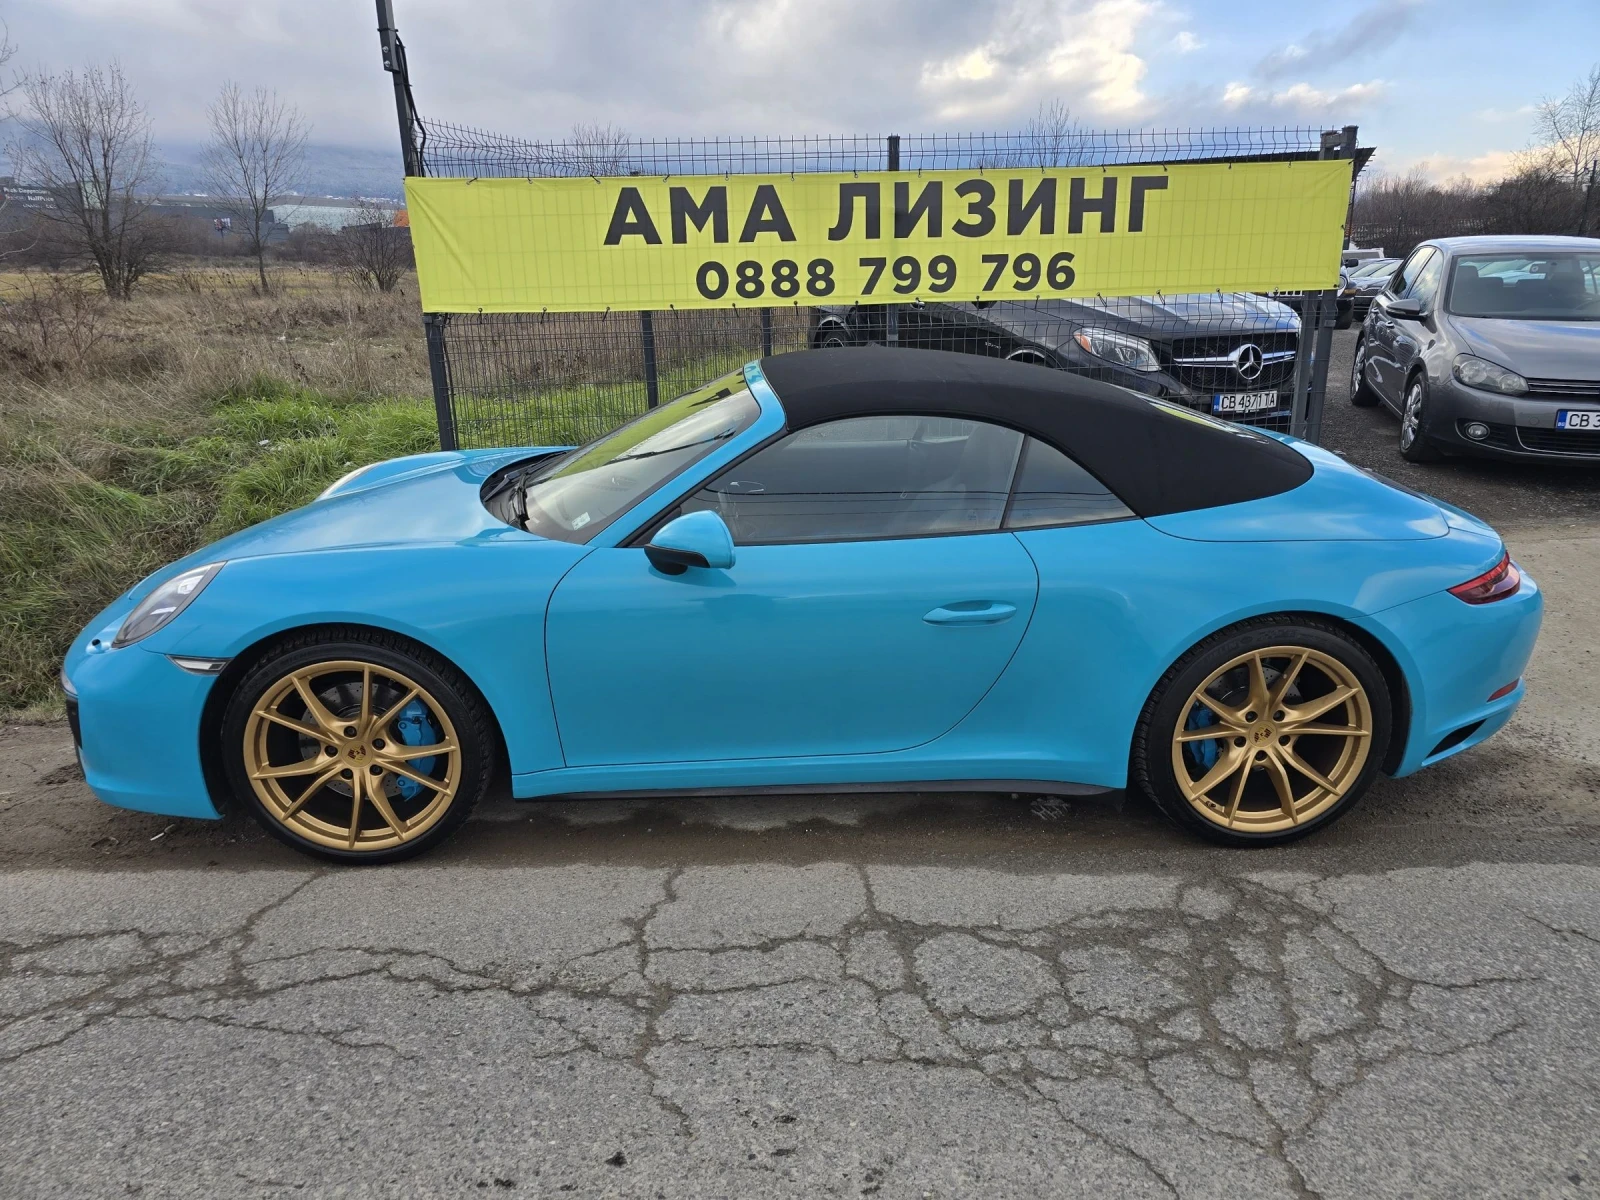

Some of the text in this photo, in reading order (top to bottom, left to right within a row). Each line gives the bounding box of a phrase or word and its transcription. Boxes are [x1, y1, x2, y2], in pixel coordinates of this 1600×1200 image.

[603, 175, 1169, 246] АМА ЛИЗИНГ
[695, 252, 1076, 300] 0888 799 796
[1569, 414, 1590, 427] CB
